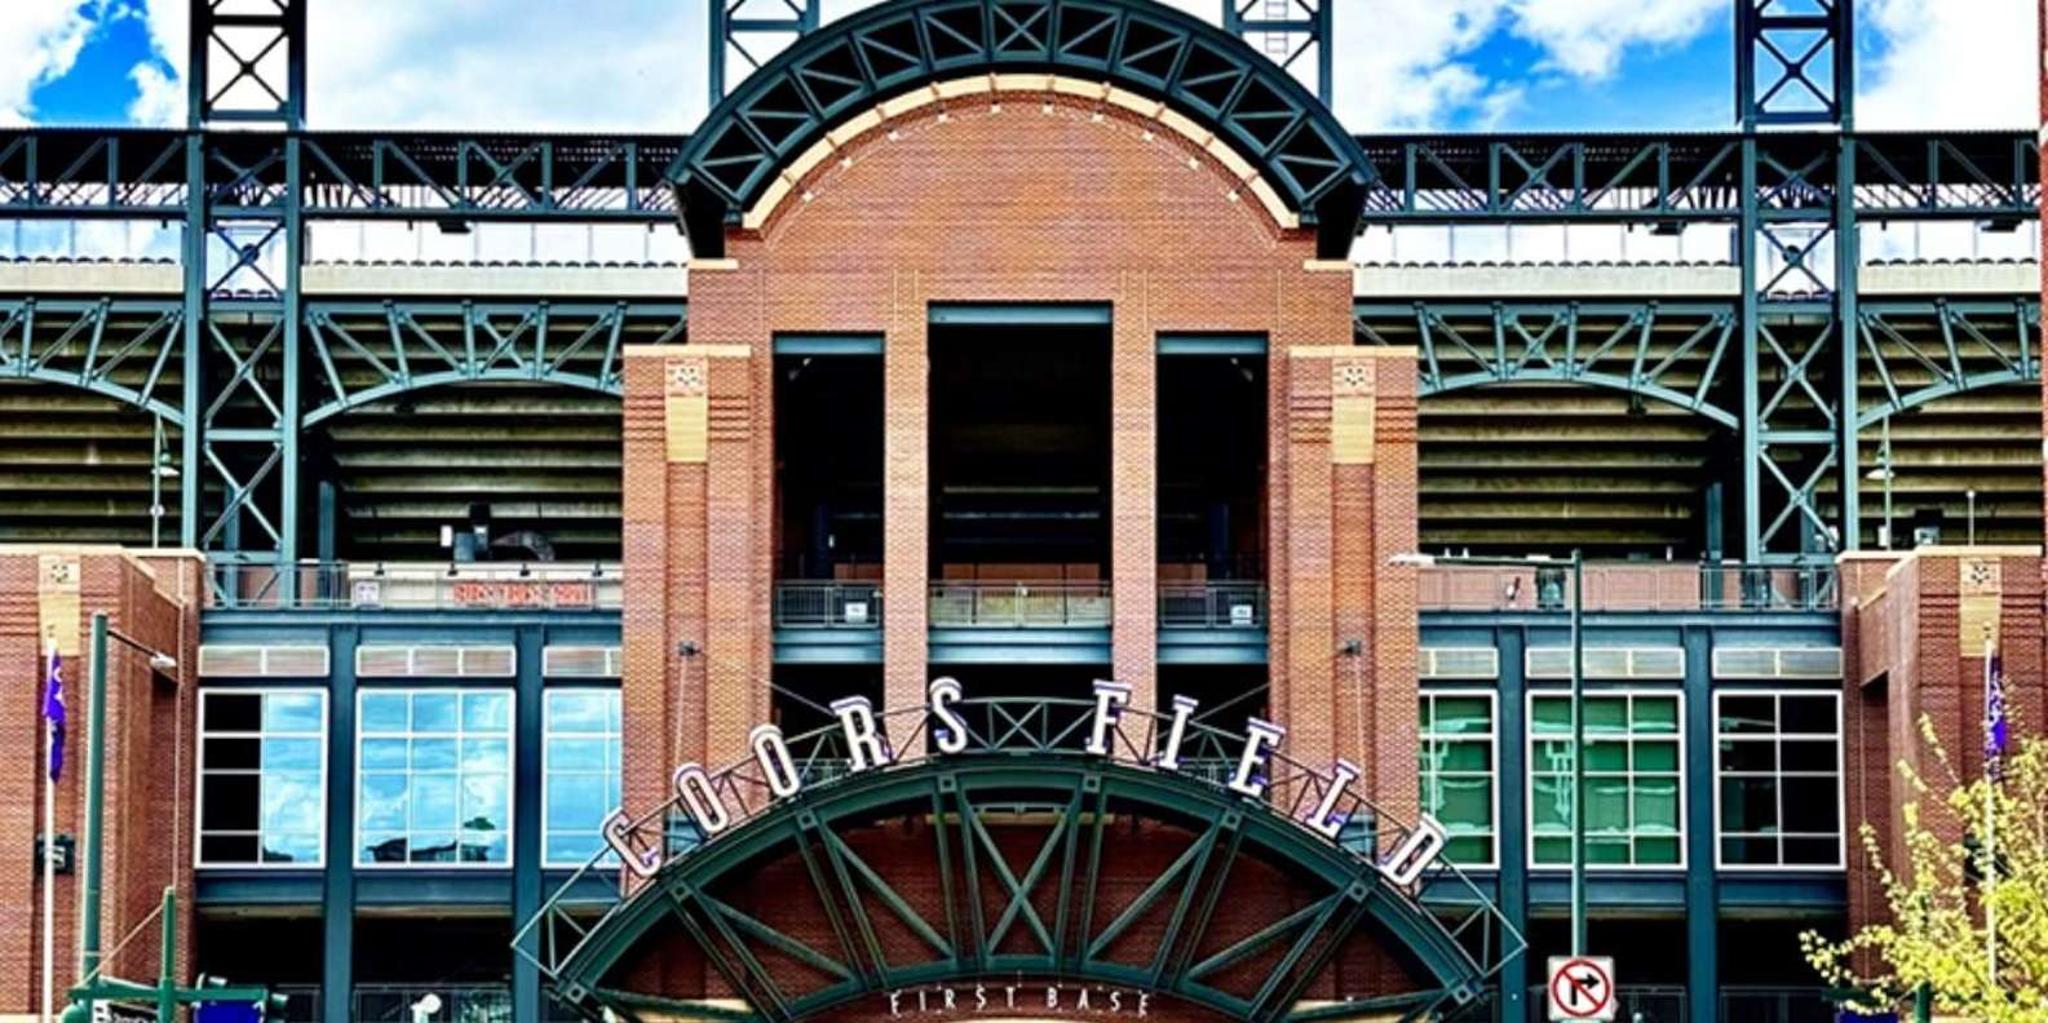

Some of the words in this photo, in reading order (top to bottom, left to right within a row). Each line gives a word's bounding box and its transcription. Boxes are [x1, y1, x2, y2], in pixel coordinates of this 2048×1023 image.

[602, 677, 969, 877] COORS
[1084, 679, 1448, 886] FIELD
[890, 985, 1015, 1018] FIRST
[1047, 987, 1149, 1017] BASE
